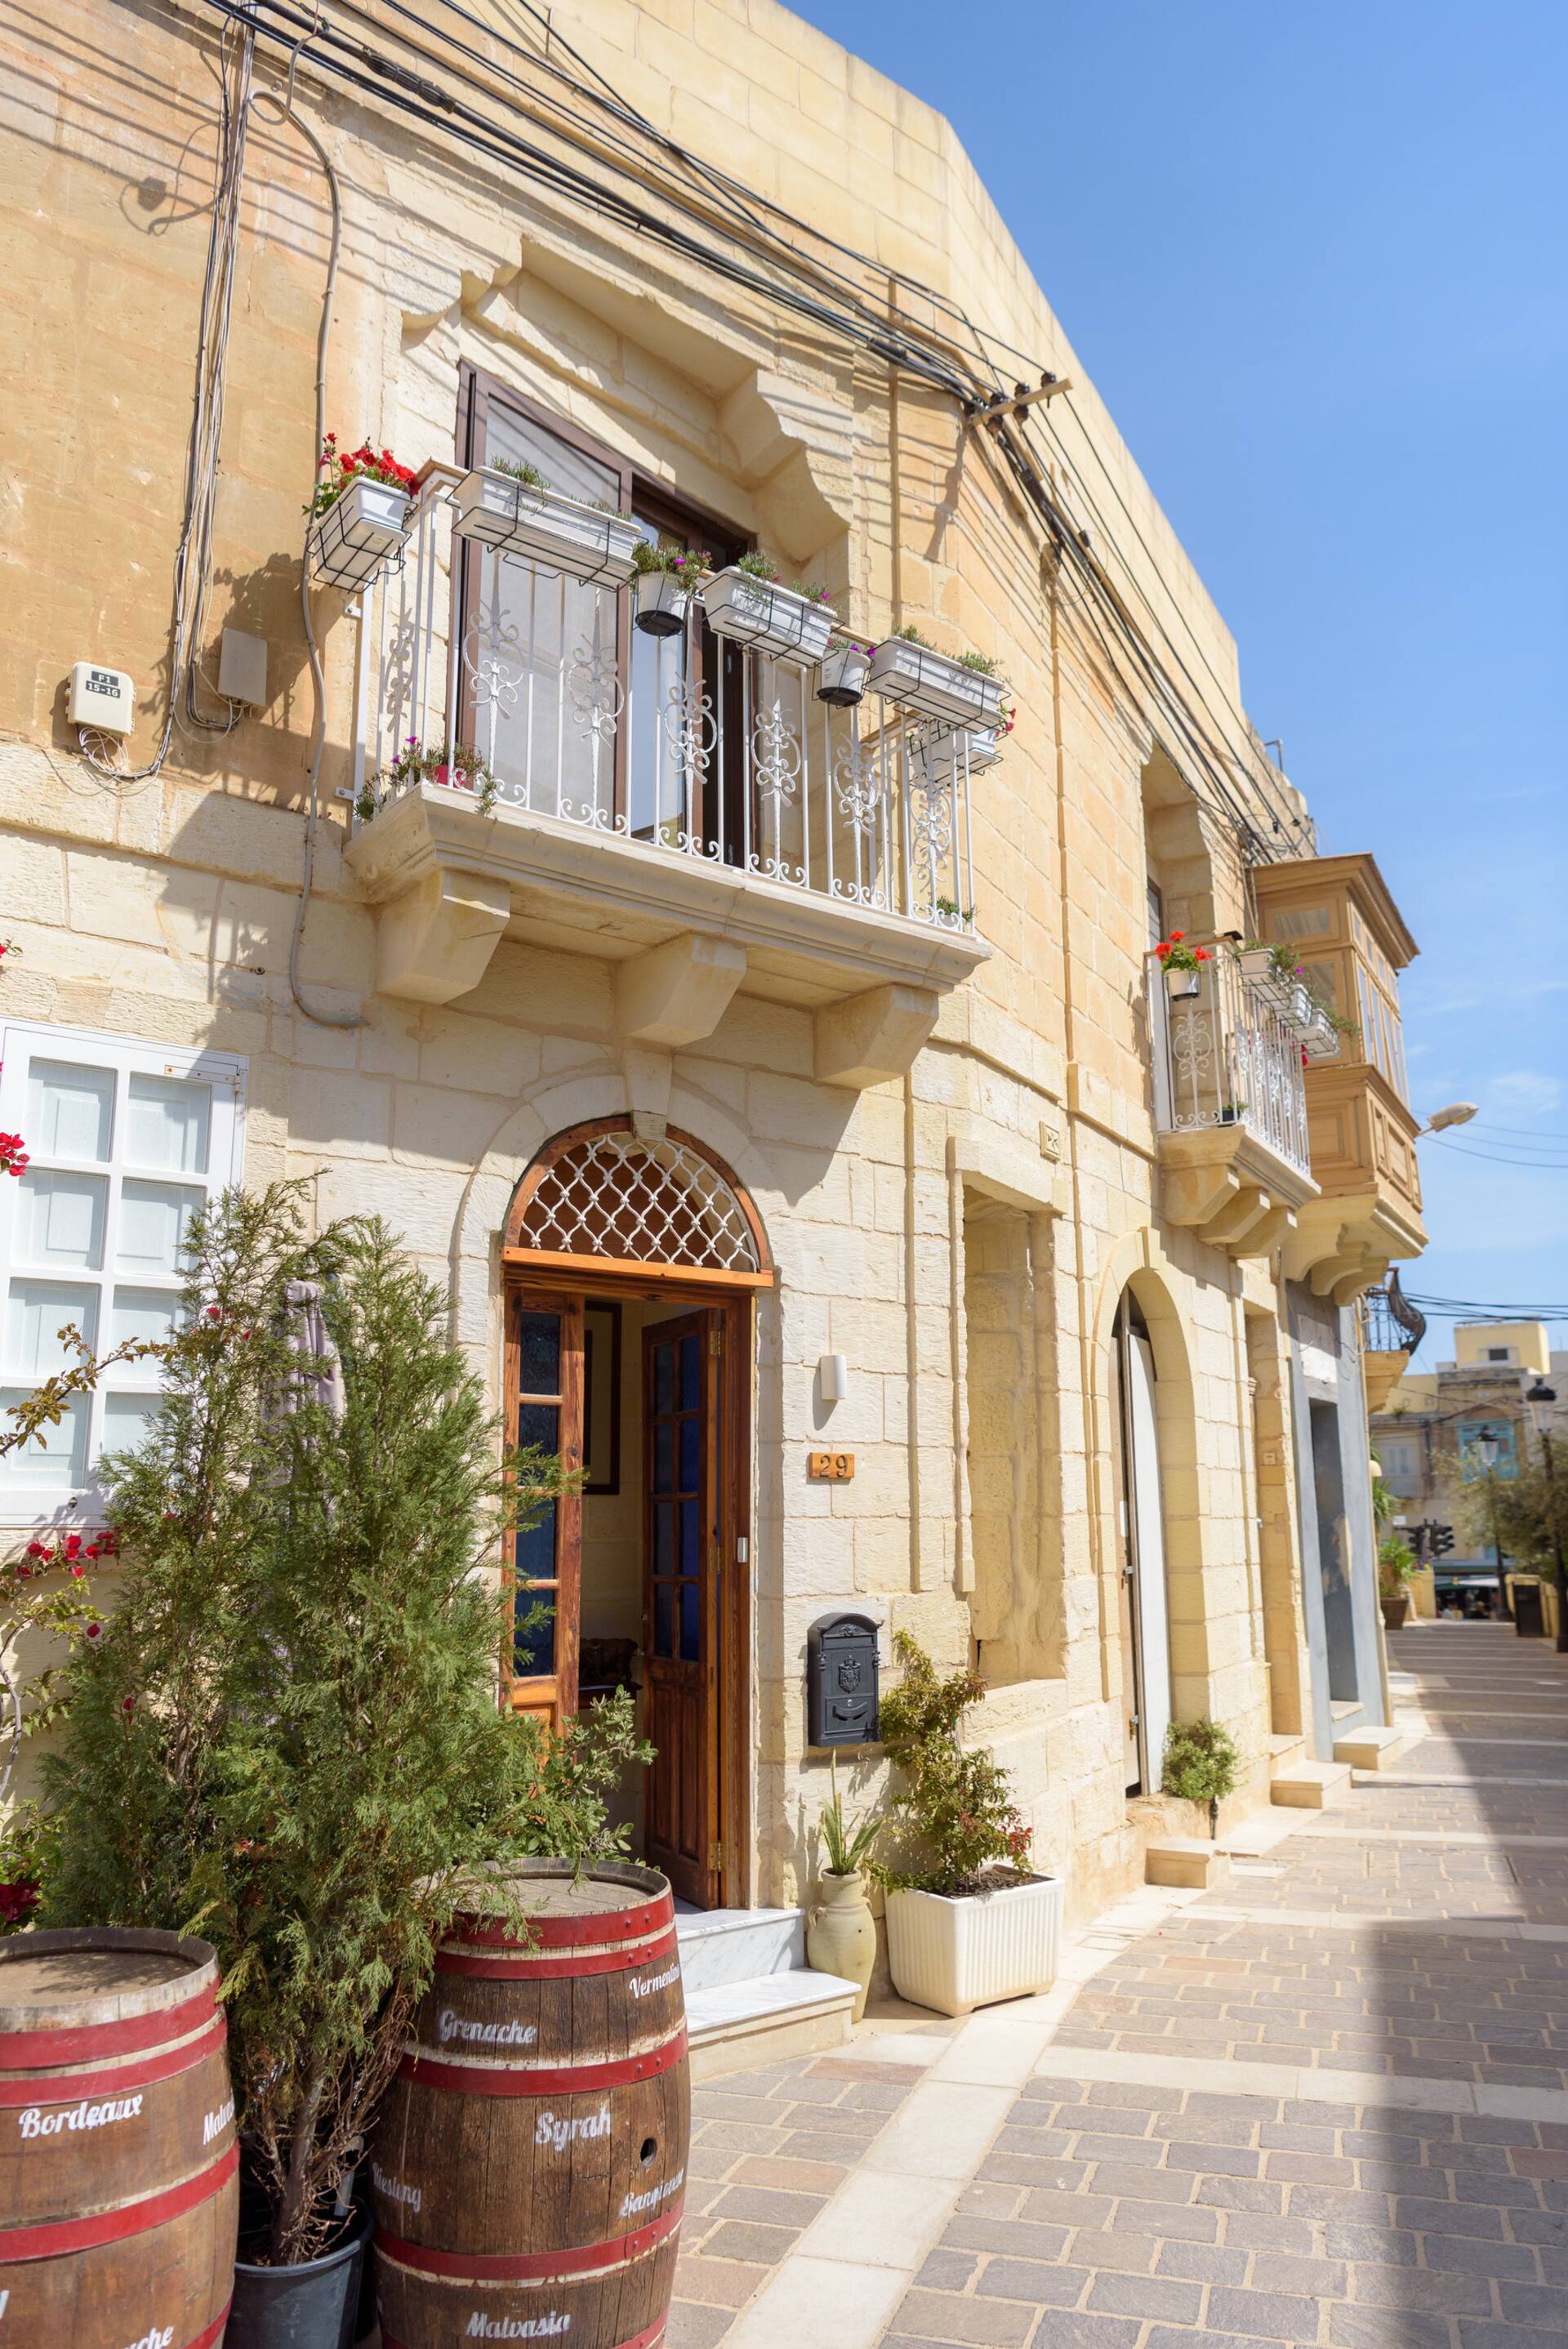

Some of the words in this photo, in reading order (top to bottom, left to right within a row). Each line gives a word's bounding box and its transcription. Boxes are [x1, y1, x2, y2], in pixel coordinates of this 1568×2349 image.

[87, 683, 118, 697] 15-16
[98, 674, 111, 684] F1
[819, 1455, 846, 1478] 29
[440, 2010, 537, 2044] Grenache
[19, 2093, 144, 2138] Bordeaux
[535, 2104, 611, 2152] Syrah
[466, 2310, 571, 2339] Malvasia
